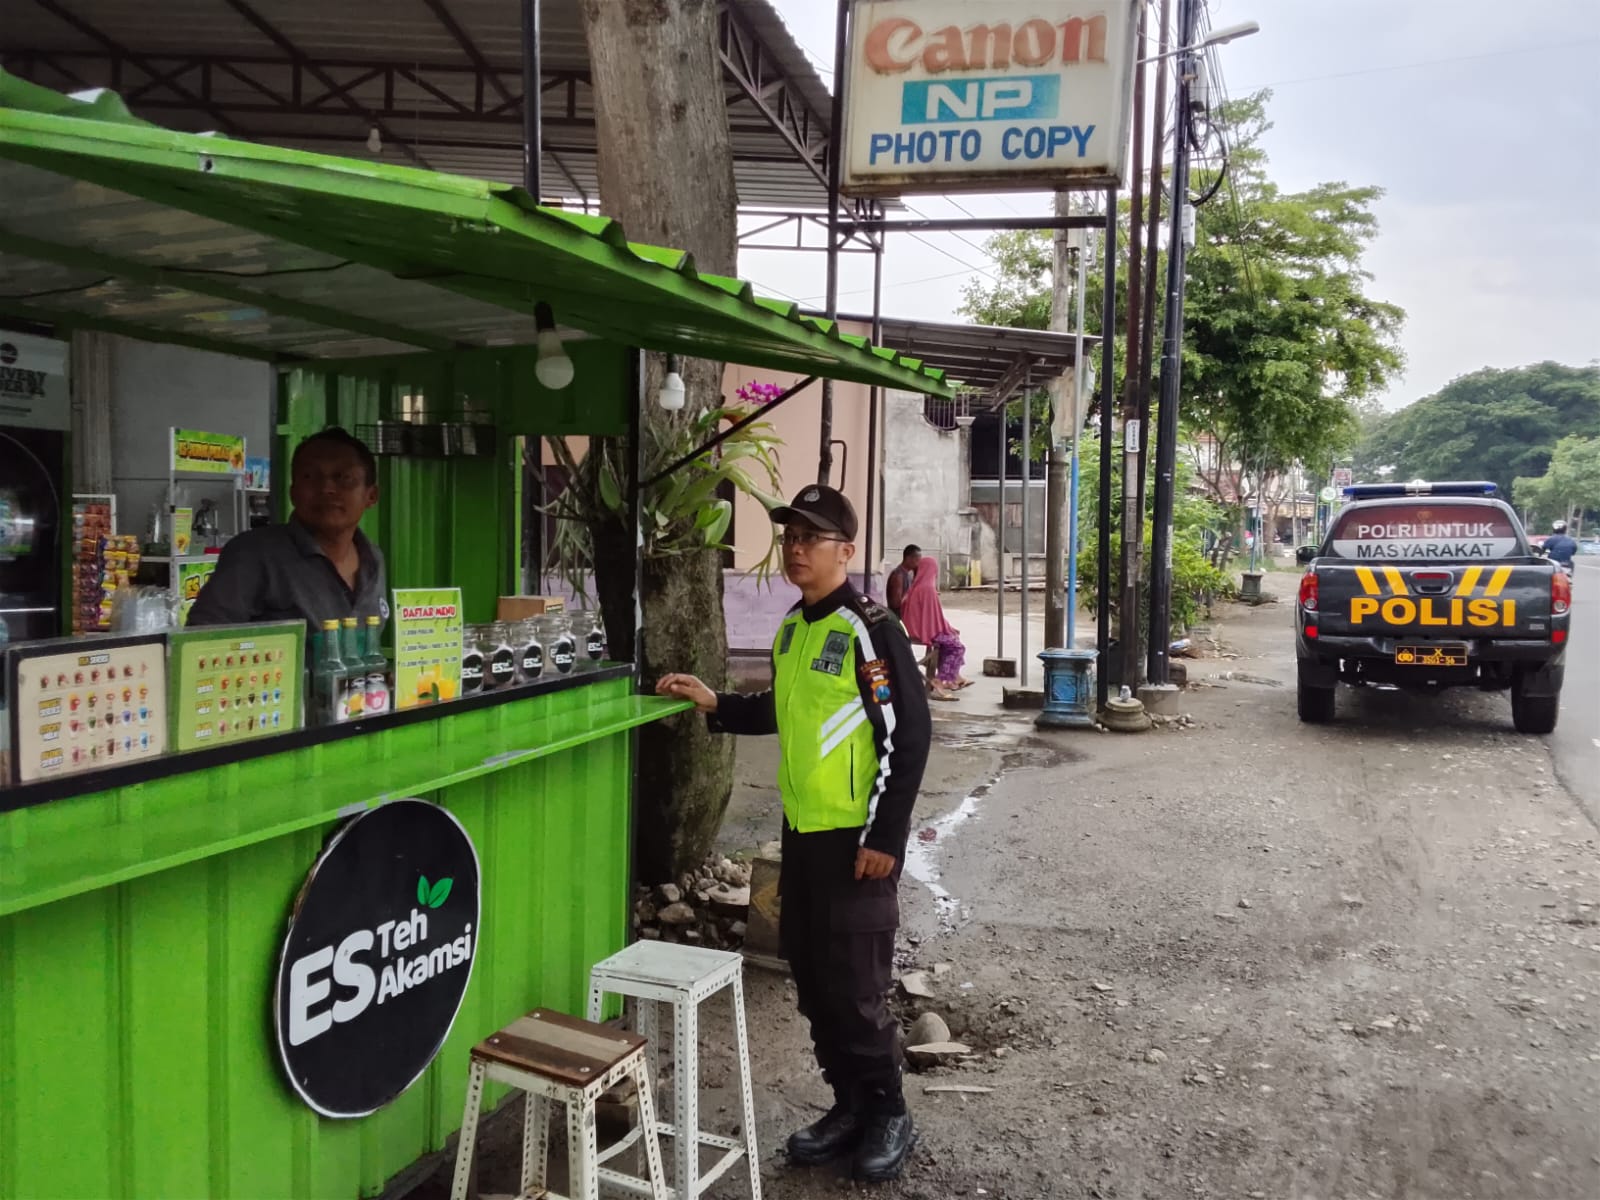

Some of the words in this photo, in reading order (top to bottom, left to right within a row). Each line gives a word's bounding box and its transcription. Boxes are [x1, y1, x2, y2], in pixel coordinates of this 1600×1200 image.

[864, 15, 1108, 74] Canon
[925, 80, 1033, 120] NP
[869, 129, 982, 165] PHOTO
[1001, 125, 1096, 160] COPY
[1358, 523, 1417, 539] POLRI
[1424, 522, 1494, 538] UNTUK
[1357, 543, 1494, 558] MASYARAKAT
[403, 607, 434, 618] DAFTAR
[435, 605, 457, 617] MENU
[1351, 598, 1516, 627] POLISI
[1433, 648, 1443, 657] X
[289, 929, 376, 1046] ES
[377, 908, 428, 958] Teh
[377, 922, 472, 1005] Akamsi
